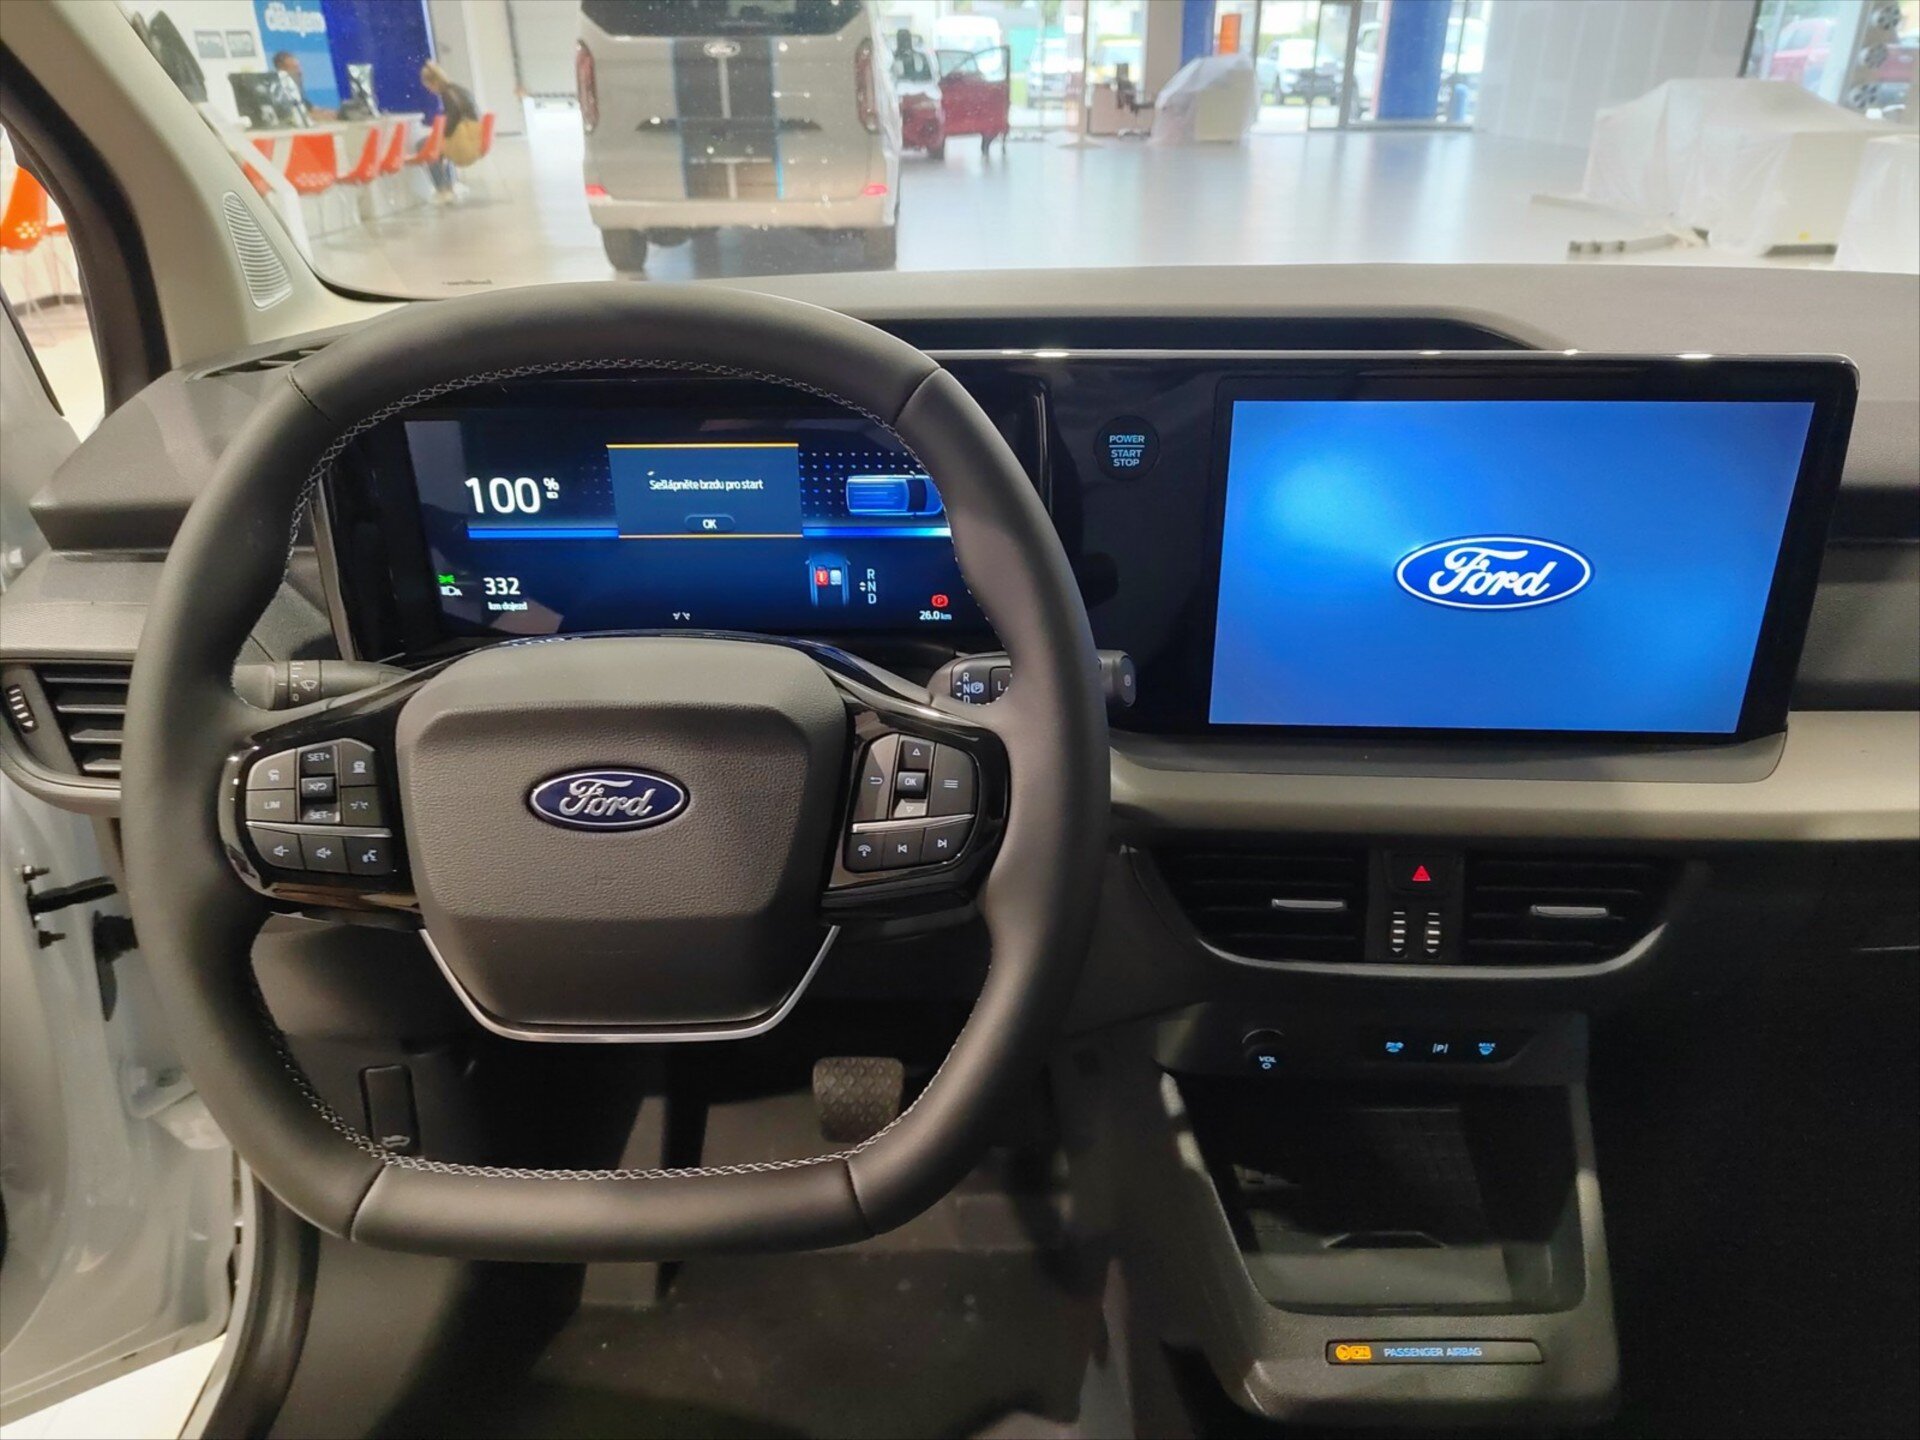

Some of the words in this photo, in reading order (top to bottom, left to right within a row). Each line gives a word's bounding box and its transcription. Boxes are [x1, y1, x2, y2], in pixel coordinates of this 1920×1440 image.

[1109, 434, 1146, 444] POWER
[1110, 449, 1143, 458] START
[1113, 458, 1140, 467] STOP
[725, 481, 741, 492] pro
[741, 479, 764, 490] start
[702, 519, 717, 530] OK
[866, 568, 876, 580] R
[1428, 546, 1558, 597] Ford
[483, 577, 521, 596] 332
[867, 580, 877, 592] N
[868, 593, 877, 605] D
[919, 610, 940, 621] 26.0
[962, 672, 970, 682] R
[962, 683, 971, 694] N
[904, 777, 917, 786] OK
[559, 778, 656, 817] Ford
[1258, 1056, 1276, 1064] VOL
[1384, 1347, 1444, 1358] PASSENGER
[1446, 1347, 1482, 1357] AIRBAG
